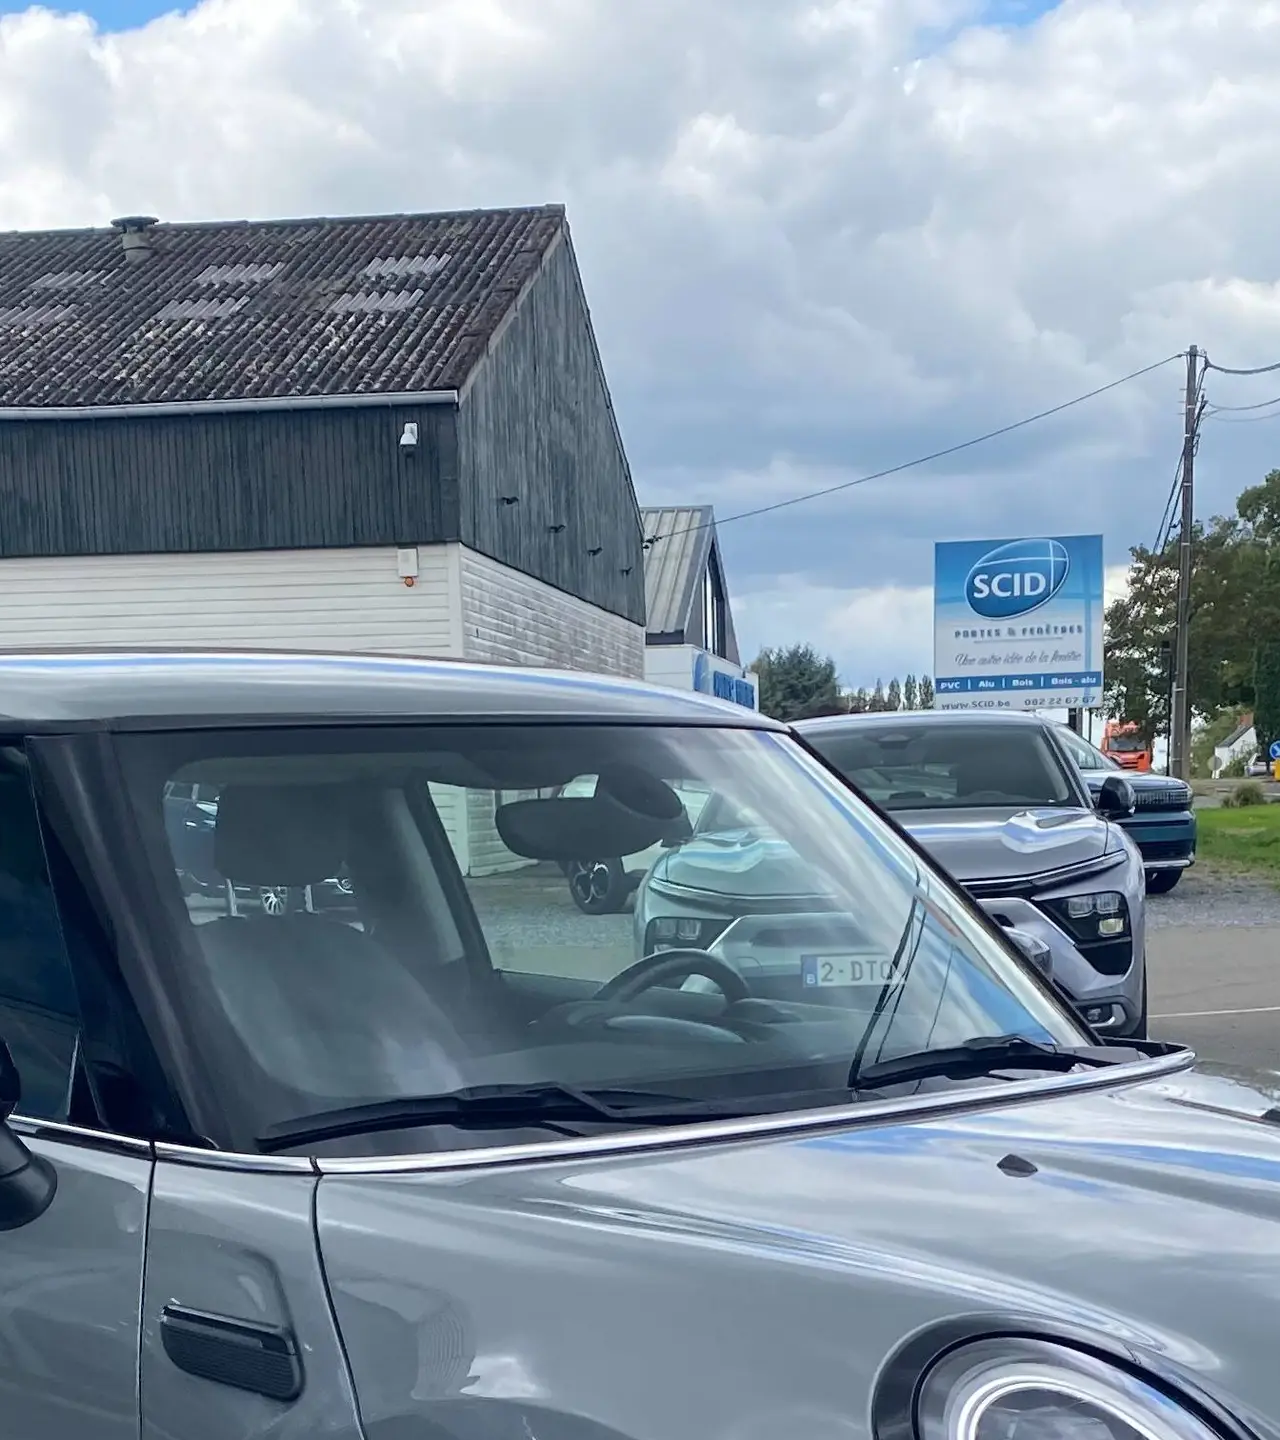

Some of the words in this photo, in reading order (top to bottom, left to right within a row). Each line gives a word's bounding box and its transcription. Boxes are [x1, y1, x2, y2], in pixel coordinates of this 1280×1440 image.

[973, 572, 1046, 598] SCID
[954, 628, 1001, 639] PORTES
[940, 681, 960, 690] PVC
[978, 680, 995, 688] Alu
[1012, 679, 1033, 687] Bois
